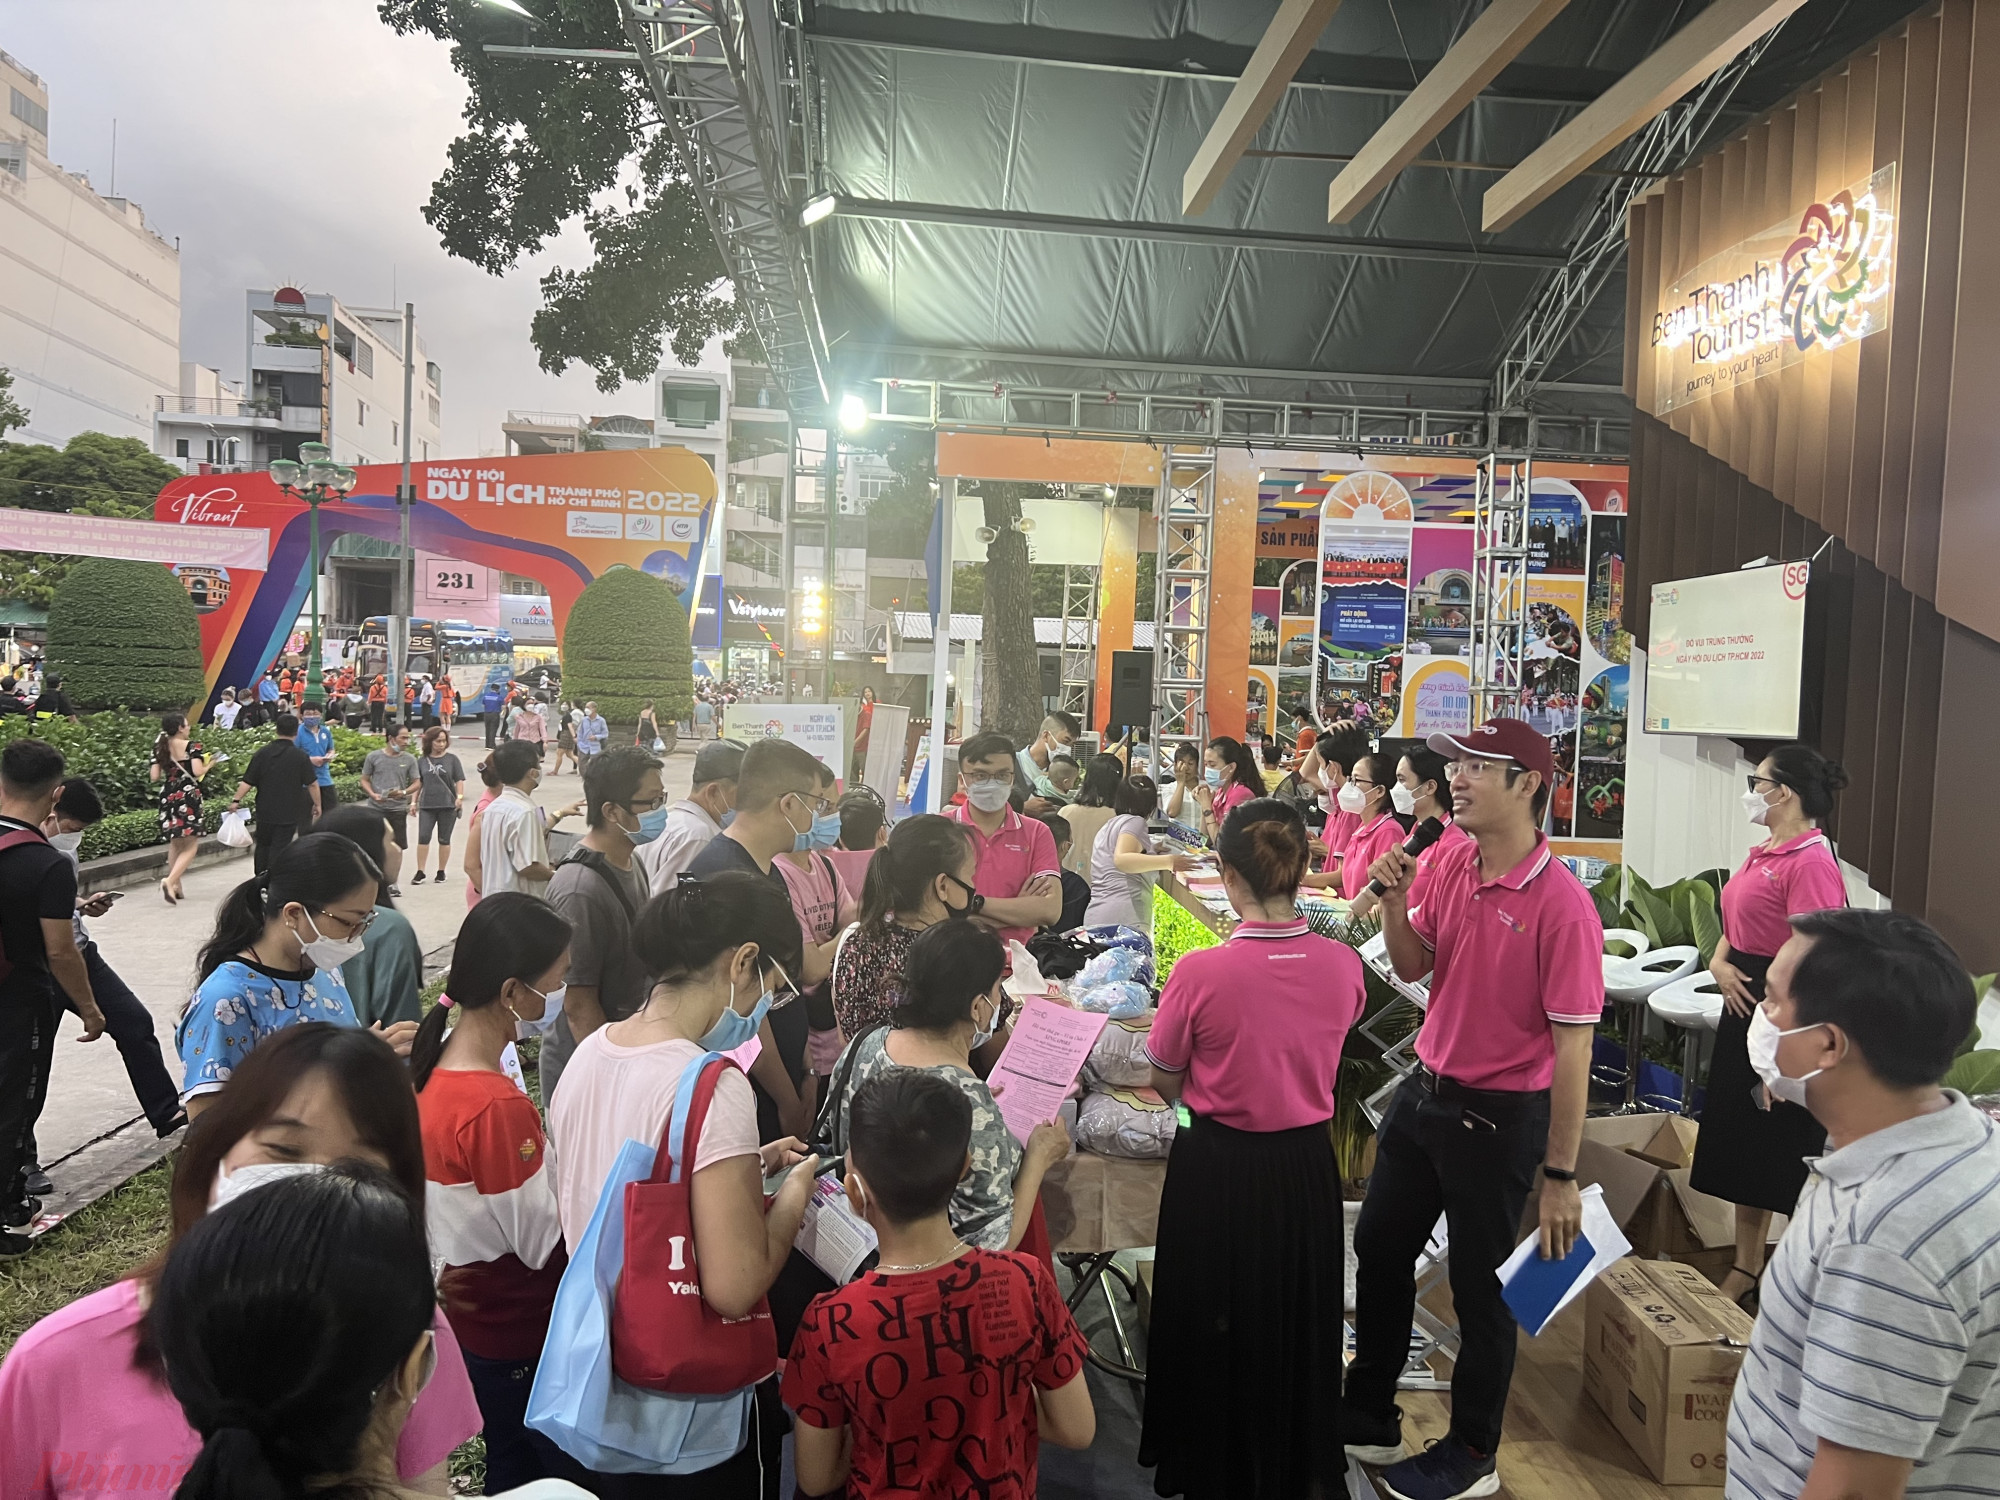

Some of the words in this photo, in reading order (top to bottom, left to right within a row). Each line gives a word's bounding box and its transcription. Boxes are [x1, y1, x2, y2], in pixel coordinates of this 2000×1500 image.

[1652, 304, 1686, 348] Ben
[1689, 260, 1770, 327] Thanh
[1689, 304, 1771, 364] Tourist
[1686, 371, 1716, 397] journey
[1718, 363, 1728, 380] to
[1729, 358, 1750, 380] your
[1752, 346, 1779, 368] heart
[427, 466, 472, 480] NGÀY
[476, 468, 505, 483] HỘI
[427, 480, 469, 501] DU
[478, 482, 545, 506] LỊCH
[547, 486, 593, 498] THÀNH
[595, 486, 622, 499] PHỐ
[627, 489, 701, 513] 2022
[171, 487, 248, 527] Vibrant
[547, 495, 565, 506] HỒ
[568, 495, 588, 507] CHÍ
[591, 498, 622, 509] MINH
[1261, 527, 1286, 546] SẢN
[436, 572, 475, 590] 231
[1786, 565, 1807, 586] SG
[511, 615, 556, 627] mattan
[1340, 609, 1354, 617] PHÁT
[1695, 638, 1705, 646] VUI
[1676, 654, 1692, 664] NGÀY
[1713, 652, 1726, 663] LỊCH
[1750, 651, 1765, 660] 2022
[745, 722, 765, 730] Thanh
[668, 1235, 686, 1271] I
